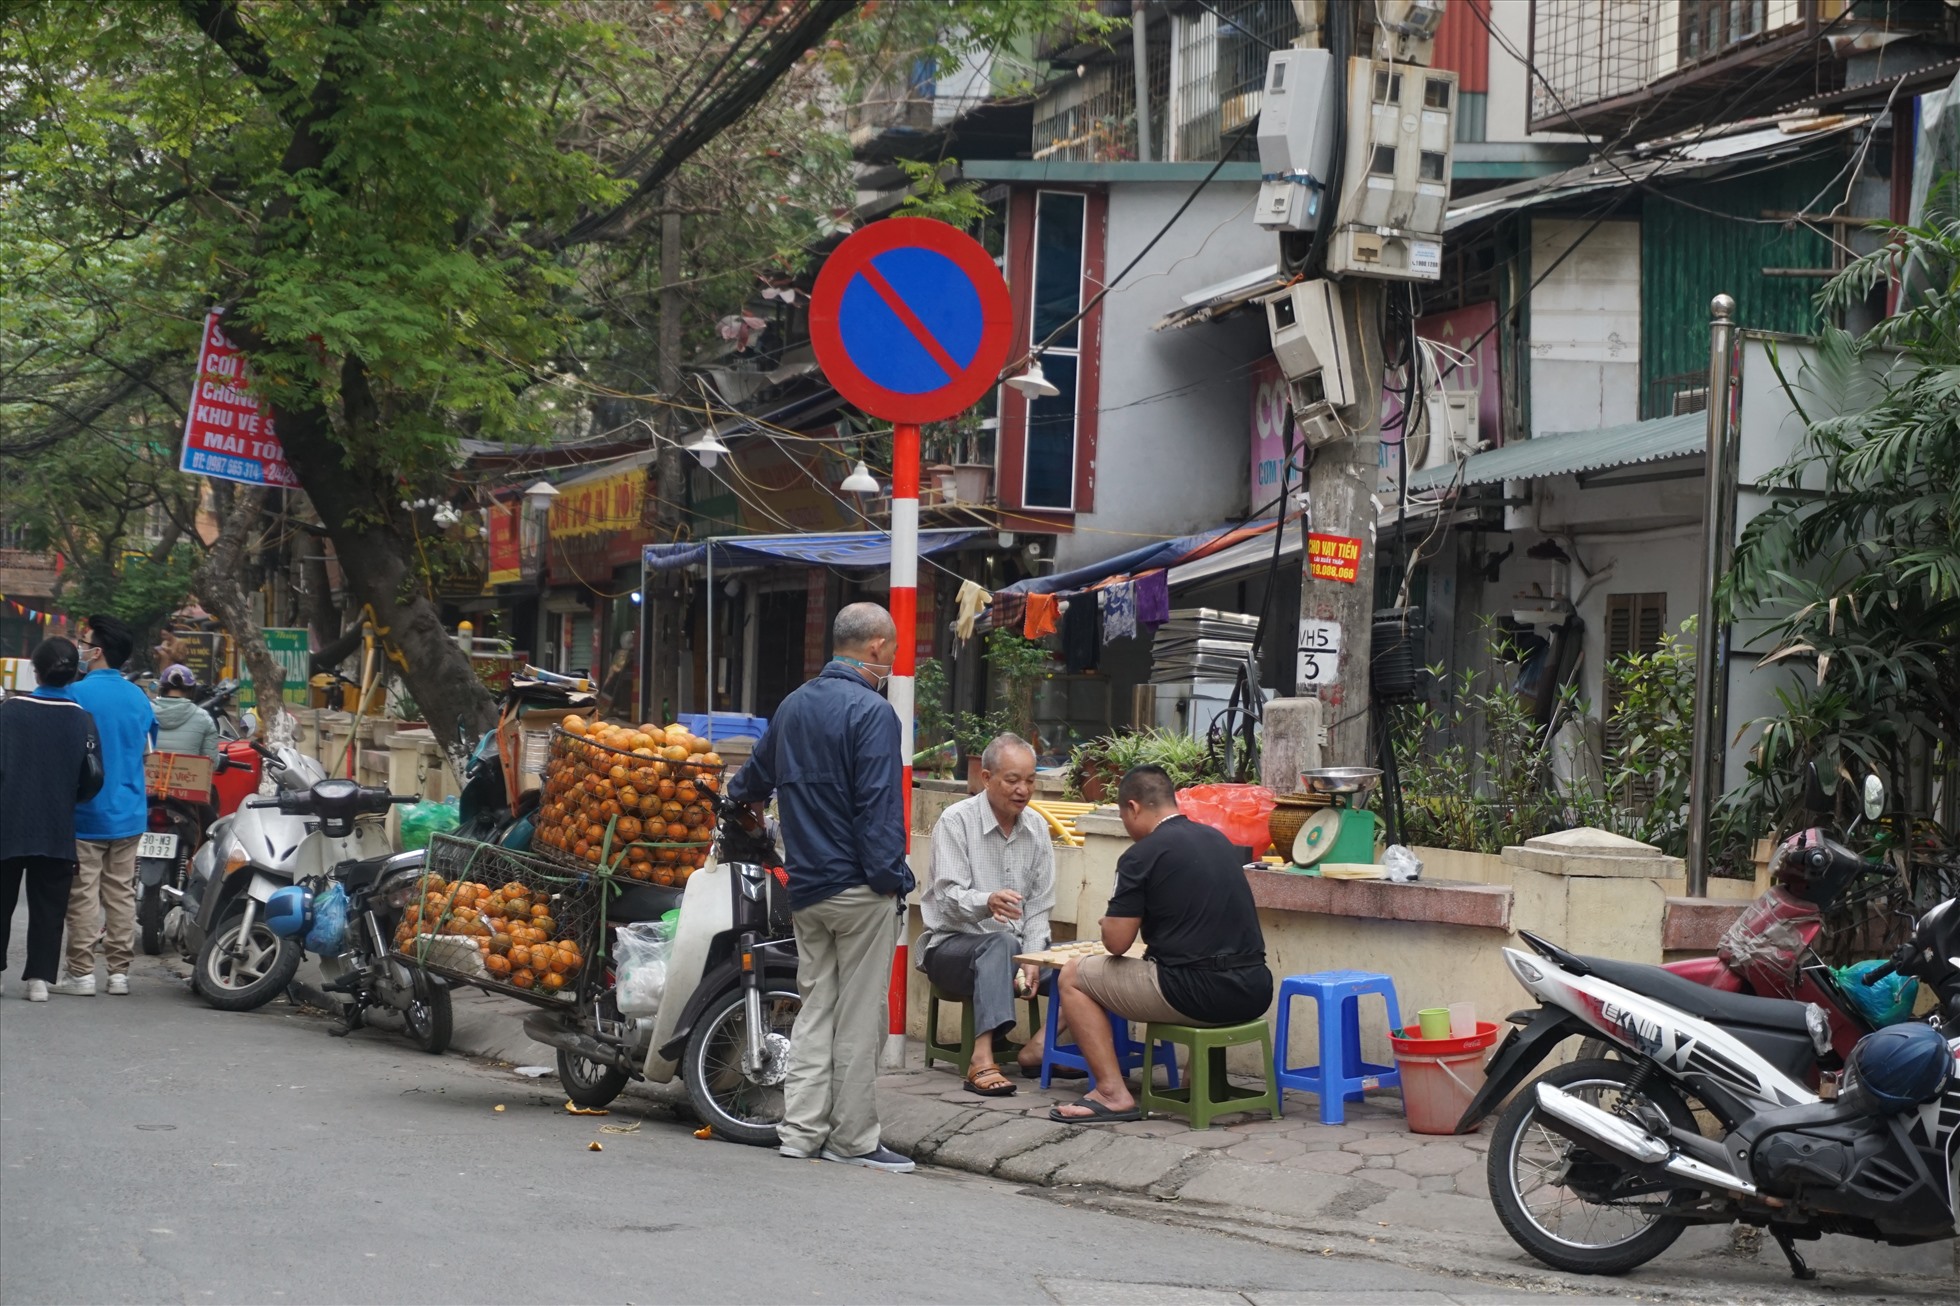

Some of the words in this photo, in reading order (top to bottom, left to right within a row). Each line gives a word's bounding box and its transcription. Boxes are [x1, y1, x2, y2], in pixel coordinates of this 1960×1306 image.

[196, 404, 233, 428] KHU
[238, 412, 260, 436] VỆ
[203, 432, 244, 454] MÁI
[1322, 541, 1337, 557] VAY
[1300, 628, 1329, 647] VH5
[1304, 653, 1319, 680] 3
